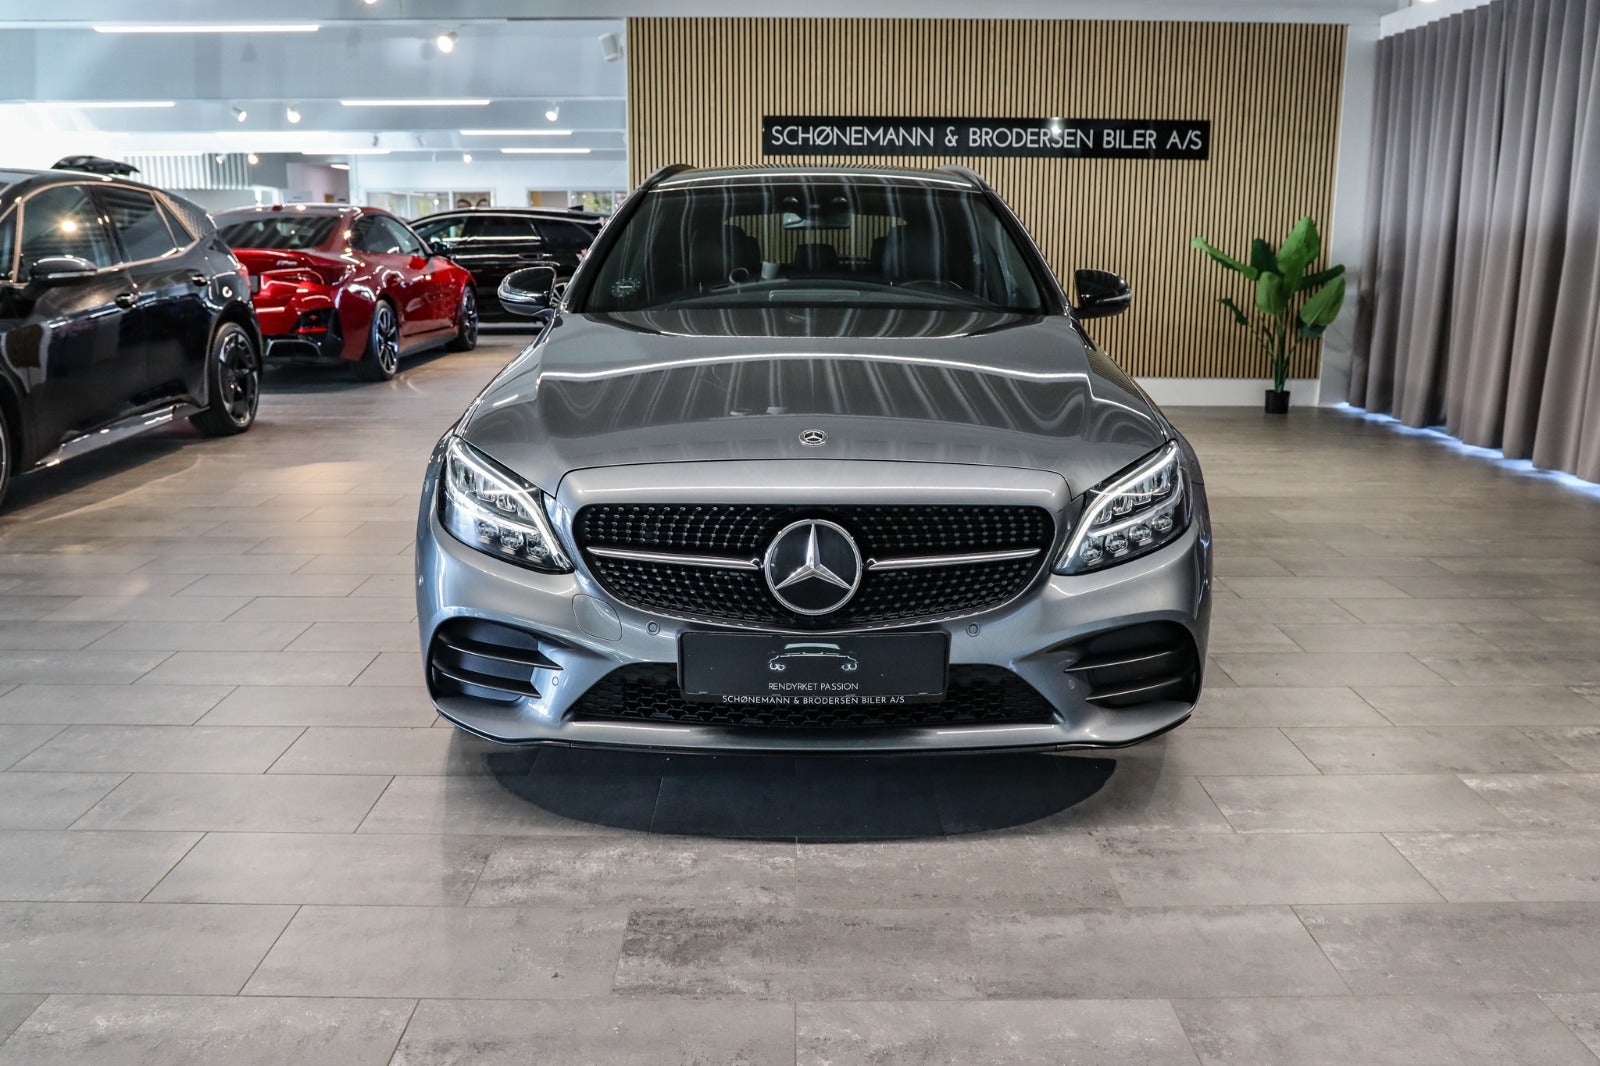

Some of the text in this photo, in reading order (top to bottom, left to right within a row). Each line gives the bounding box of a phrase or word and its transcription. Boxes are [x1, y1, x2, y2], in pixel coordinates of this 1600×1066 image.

[771, 125, 1202, 150] SCHØNEMANN & BRODERSEN BILER A/S
[768, 682, 859, 691] RENDYRKET PASSION
[722, 695, 905, 705] SCHØNEMANN & BRODERSEN BILER A/S
